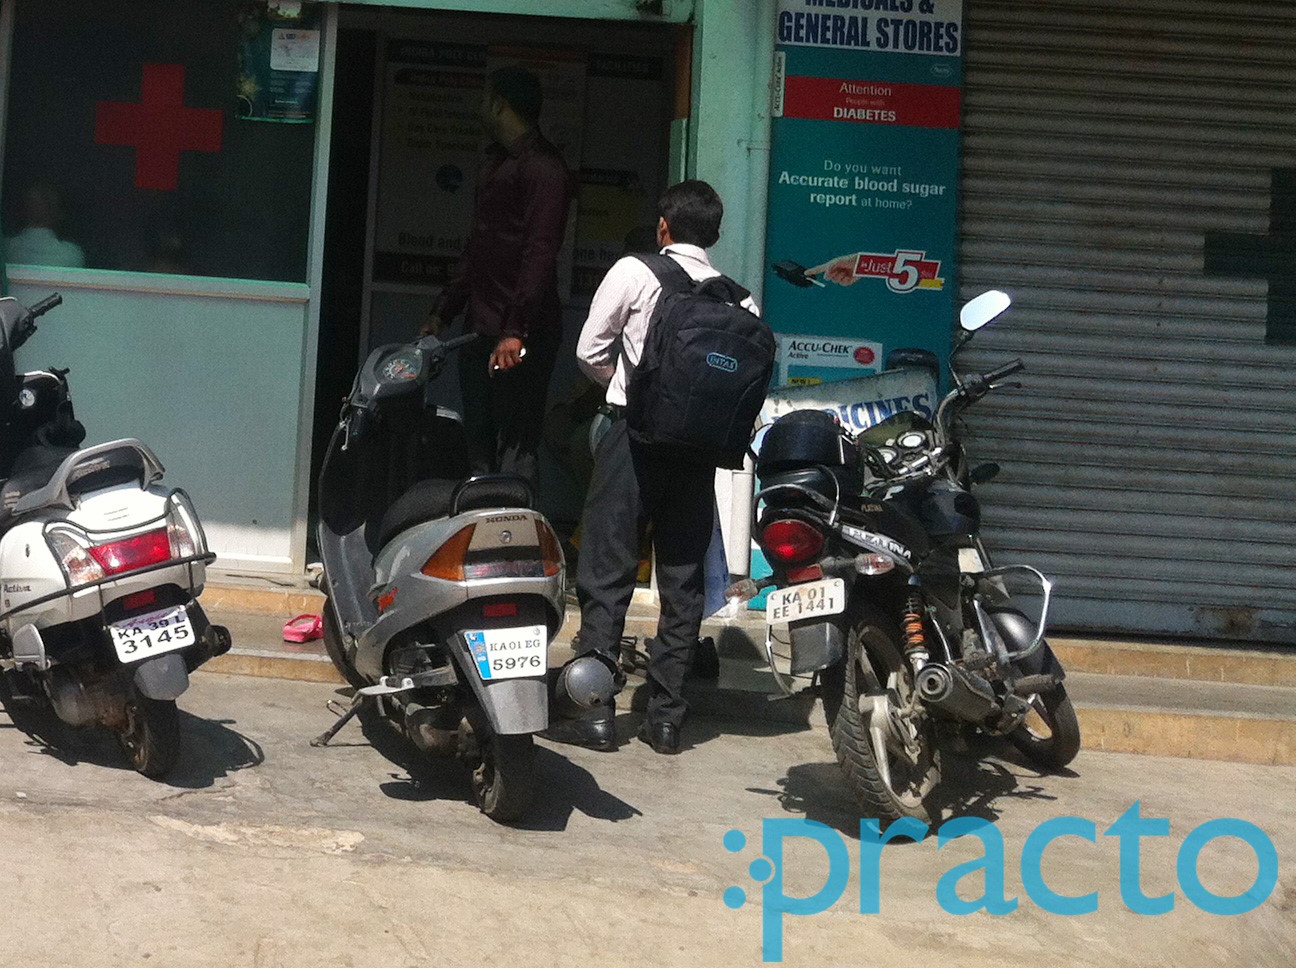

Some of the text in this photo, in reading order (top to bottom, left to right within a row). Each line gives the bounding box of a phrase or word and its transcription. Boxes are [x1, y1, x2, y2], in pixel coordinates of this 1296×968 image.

[779, 10, 959, 54] GENERAL STORES
[839, 82, 892, 97] Attention
[833, 106, 896, 122] DIABETES
[824, 160, 902, 176] Do you want
[778, 171, 946, 197] Accurate blood sugar
[810, 190, 912, 210] report at home?
[865, 259, 892, 273] Just
[888, 251, 923, 292] 5
[486, 515, 528, 523] HONDA
[782, 587, 826, 605] KA 01
[773, 598, 834, 619] EE 1441
[118, 627, 142, 640] KA
[148, 619, 170, 631] 39
[176, 615, 186, 624] L
[123, 626, 190, 654] 3145
[493, 655, 541, 671] 5976
